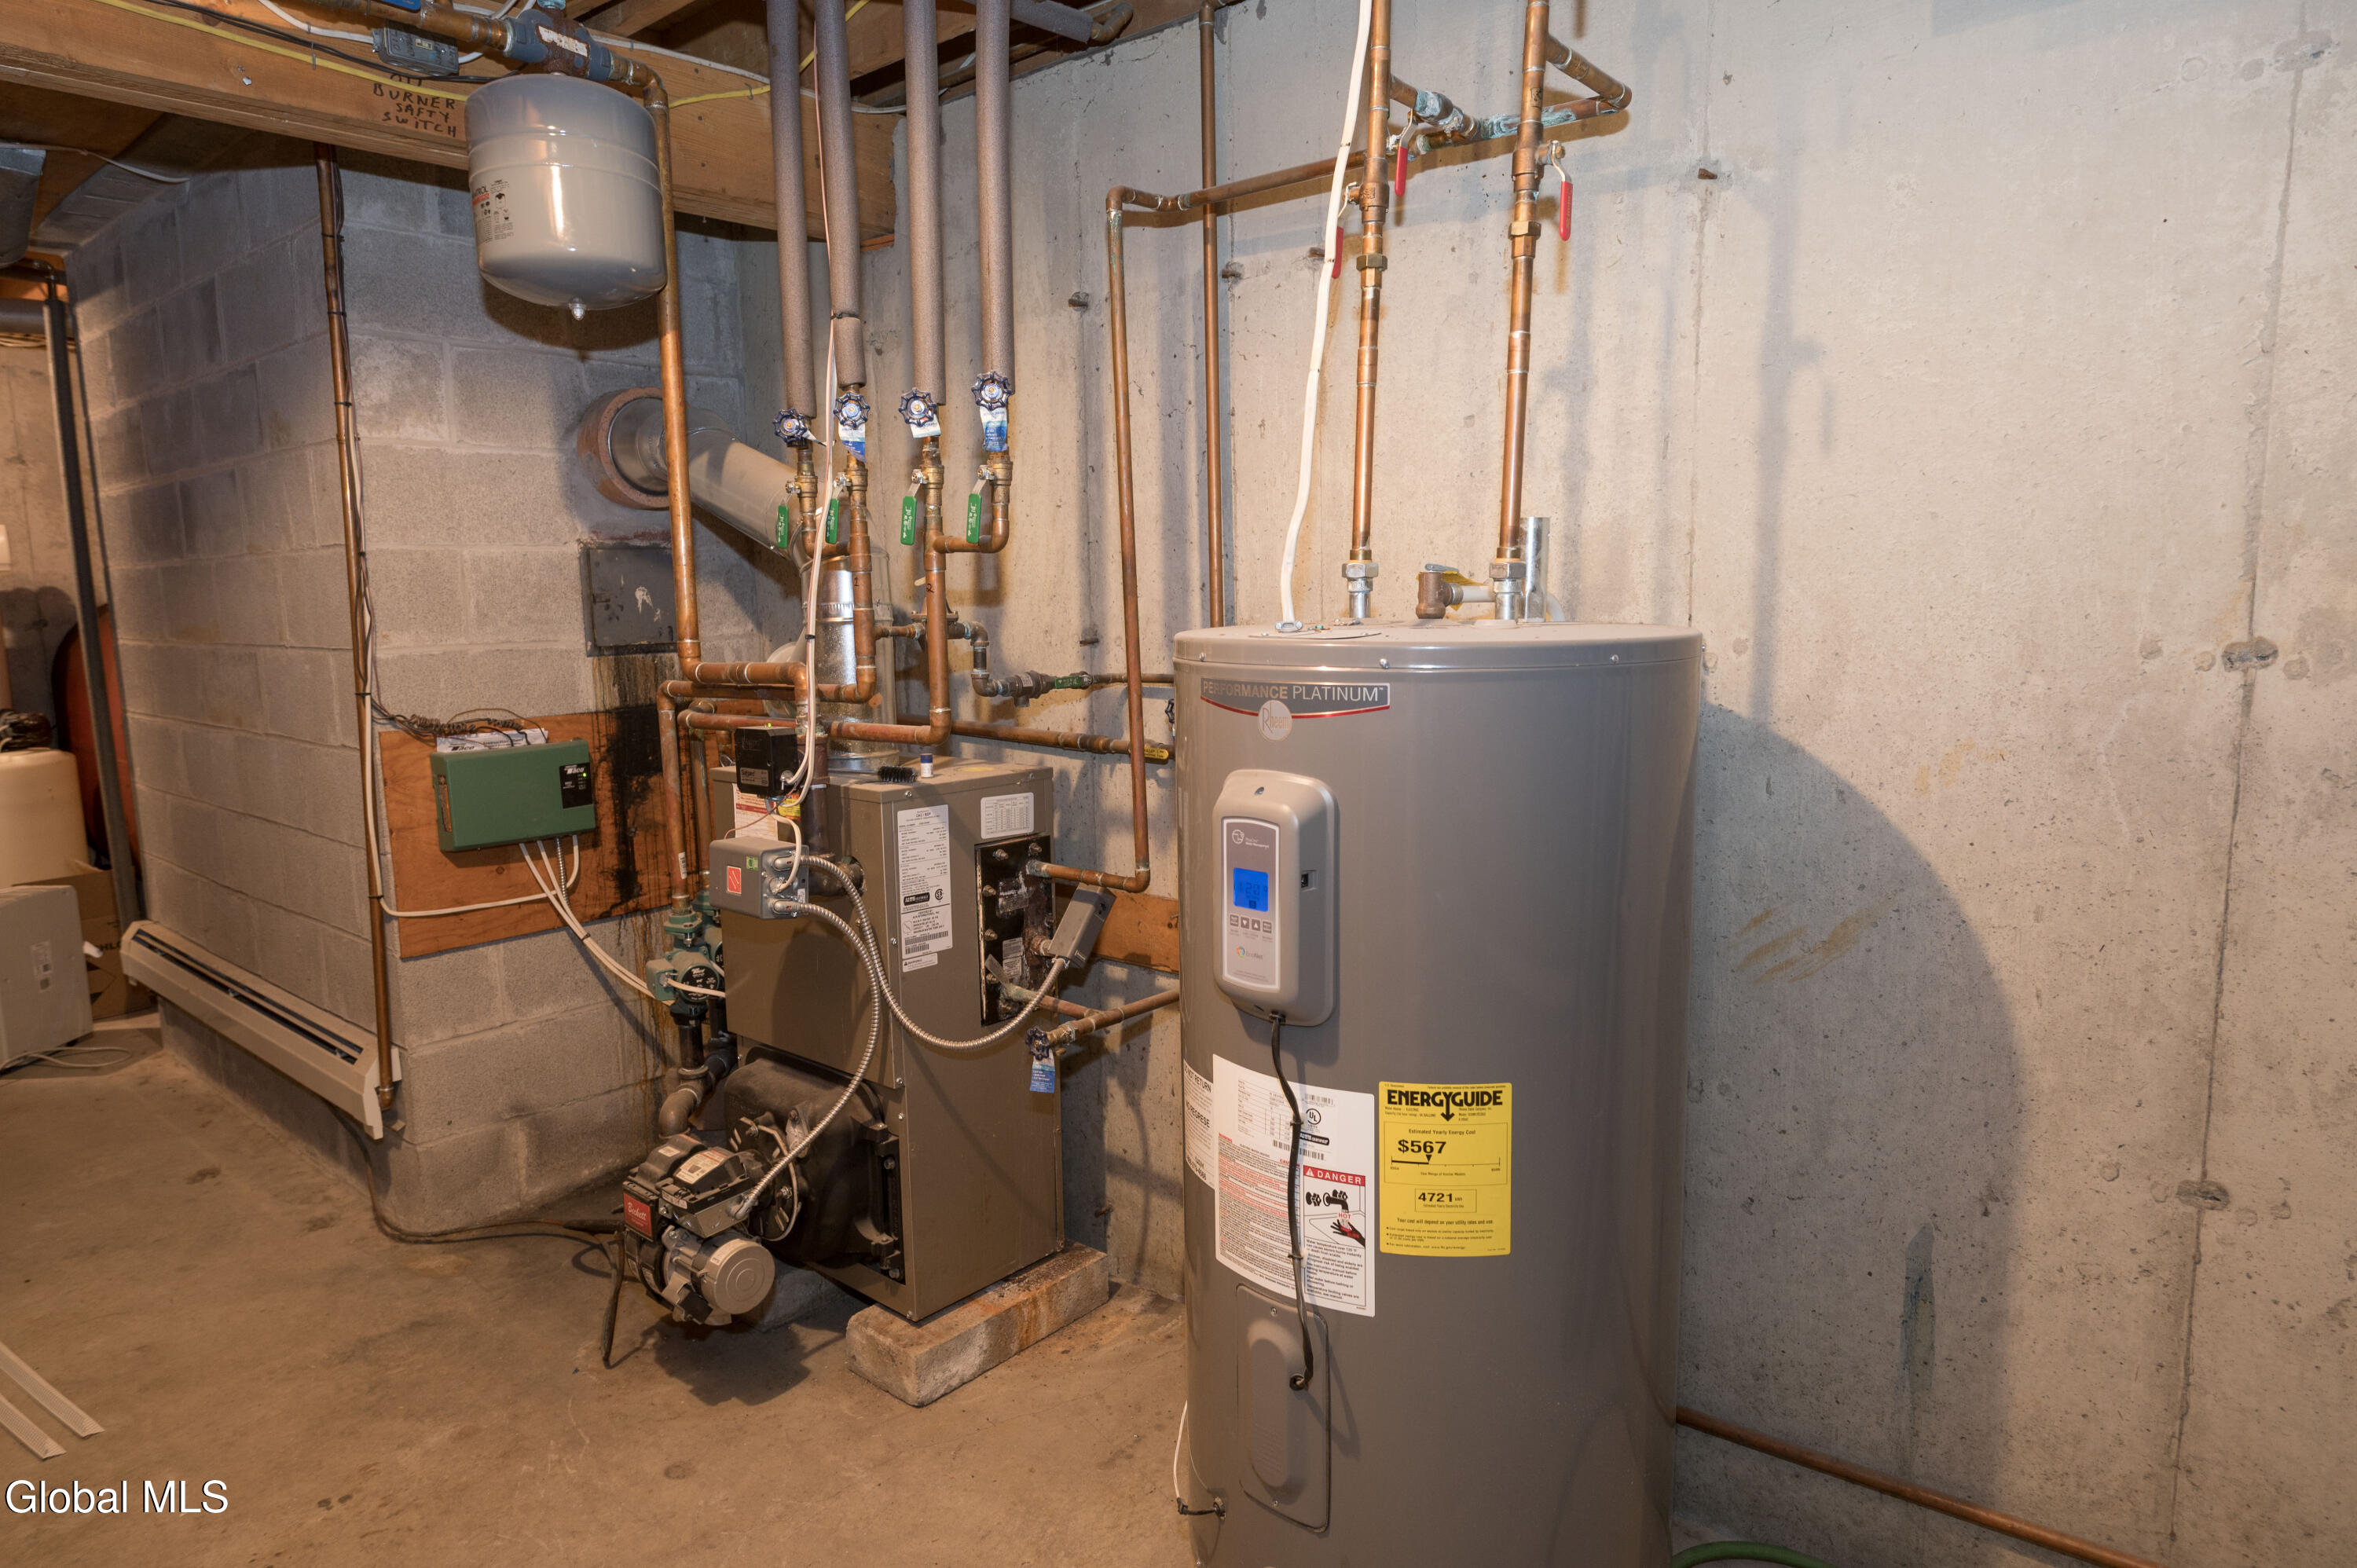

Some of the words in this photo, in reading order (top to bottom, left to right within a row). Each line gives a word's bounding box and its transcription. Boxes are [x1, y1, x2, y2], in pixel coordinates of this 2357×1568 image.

[373, 83, 456, 110] BURNER
[396, 103, 449, 123] SAFTY
[1203, 681, 1288, 699] PERFORMANCE
[1262, 701, 1289, 733] Rheem
[564, 765, 585, 774] Taco
[1194, 1074, 1211, 1093] RETURN
[1387, 1090, 1503, 1107] ENERGYGUIDE
[1190, 1103, 1210, 1128] REGRESE
[1398, 1139, 1446, 1154] $567
[1317, 1171, 1361, 1184] DANGER
[1418, 1193, 1452, 1202] 4721
[628, 1202, 647, 1221] Beckett
